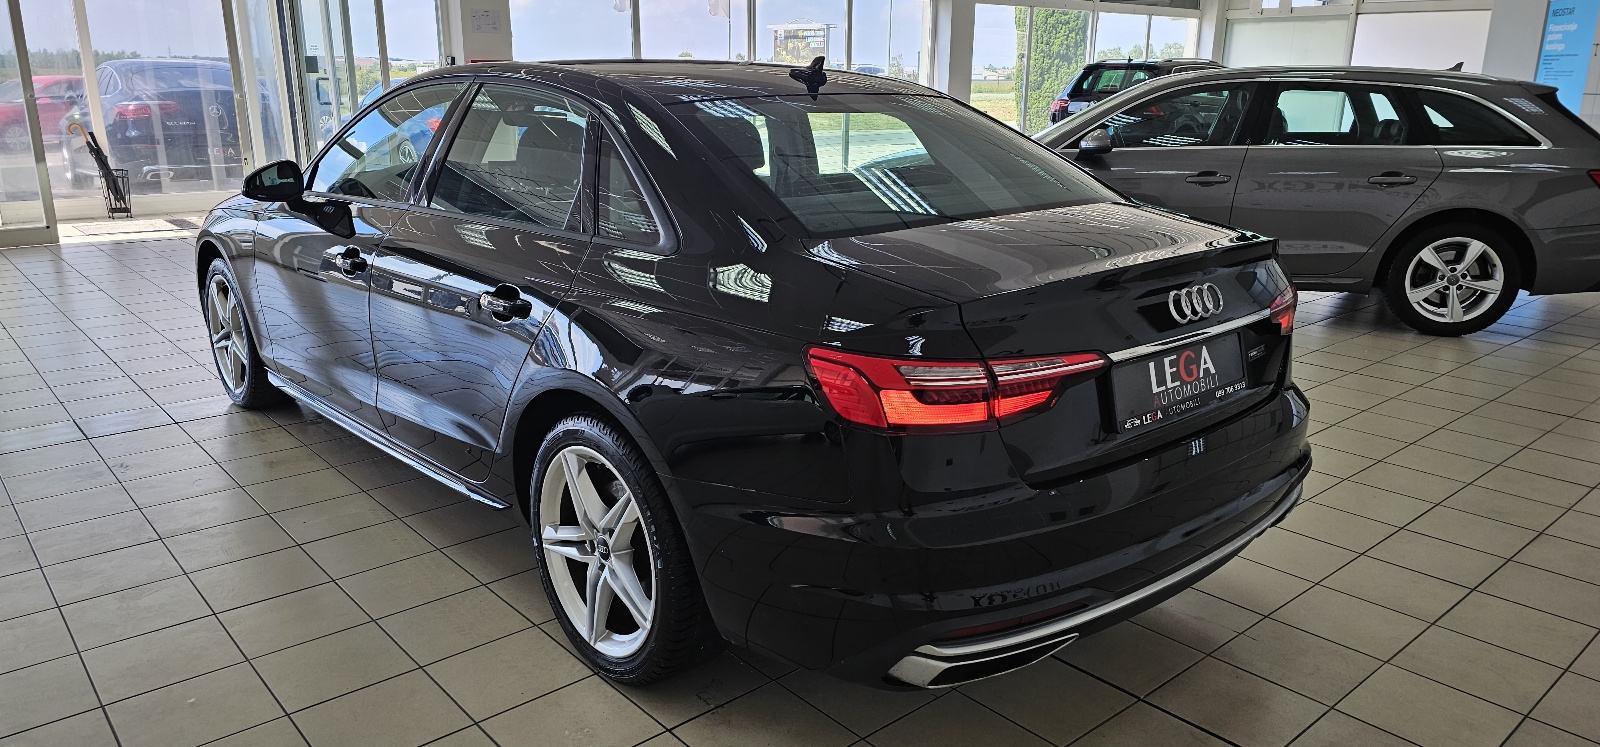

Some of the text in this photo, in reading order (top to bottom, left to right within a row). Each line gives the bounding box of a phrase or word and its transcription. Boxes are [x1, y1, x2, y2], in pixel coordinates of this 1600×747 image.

[1148, 345, 1216, 393] LEGA
[1152, 374, 1219, 409] AUTOMOBILI
[1142, 397, 1201, 425] LEGA UTOMOBILI
